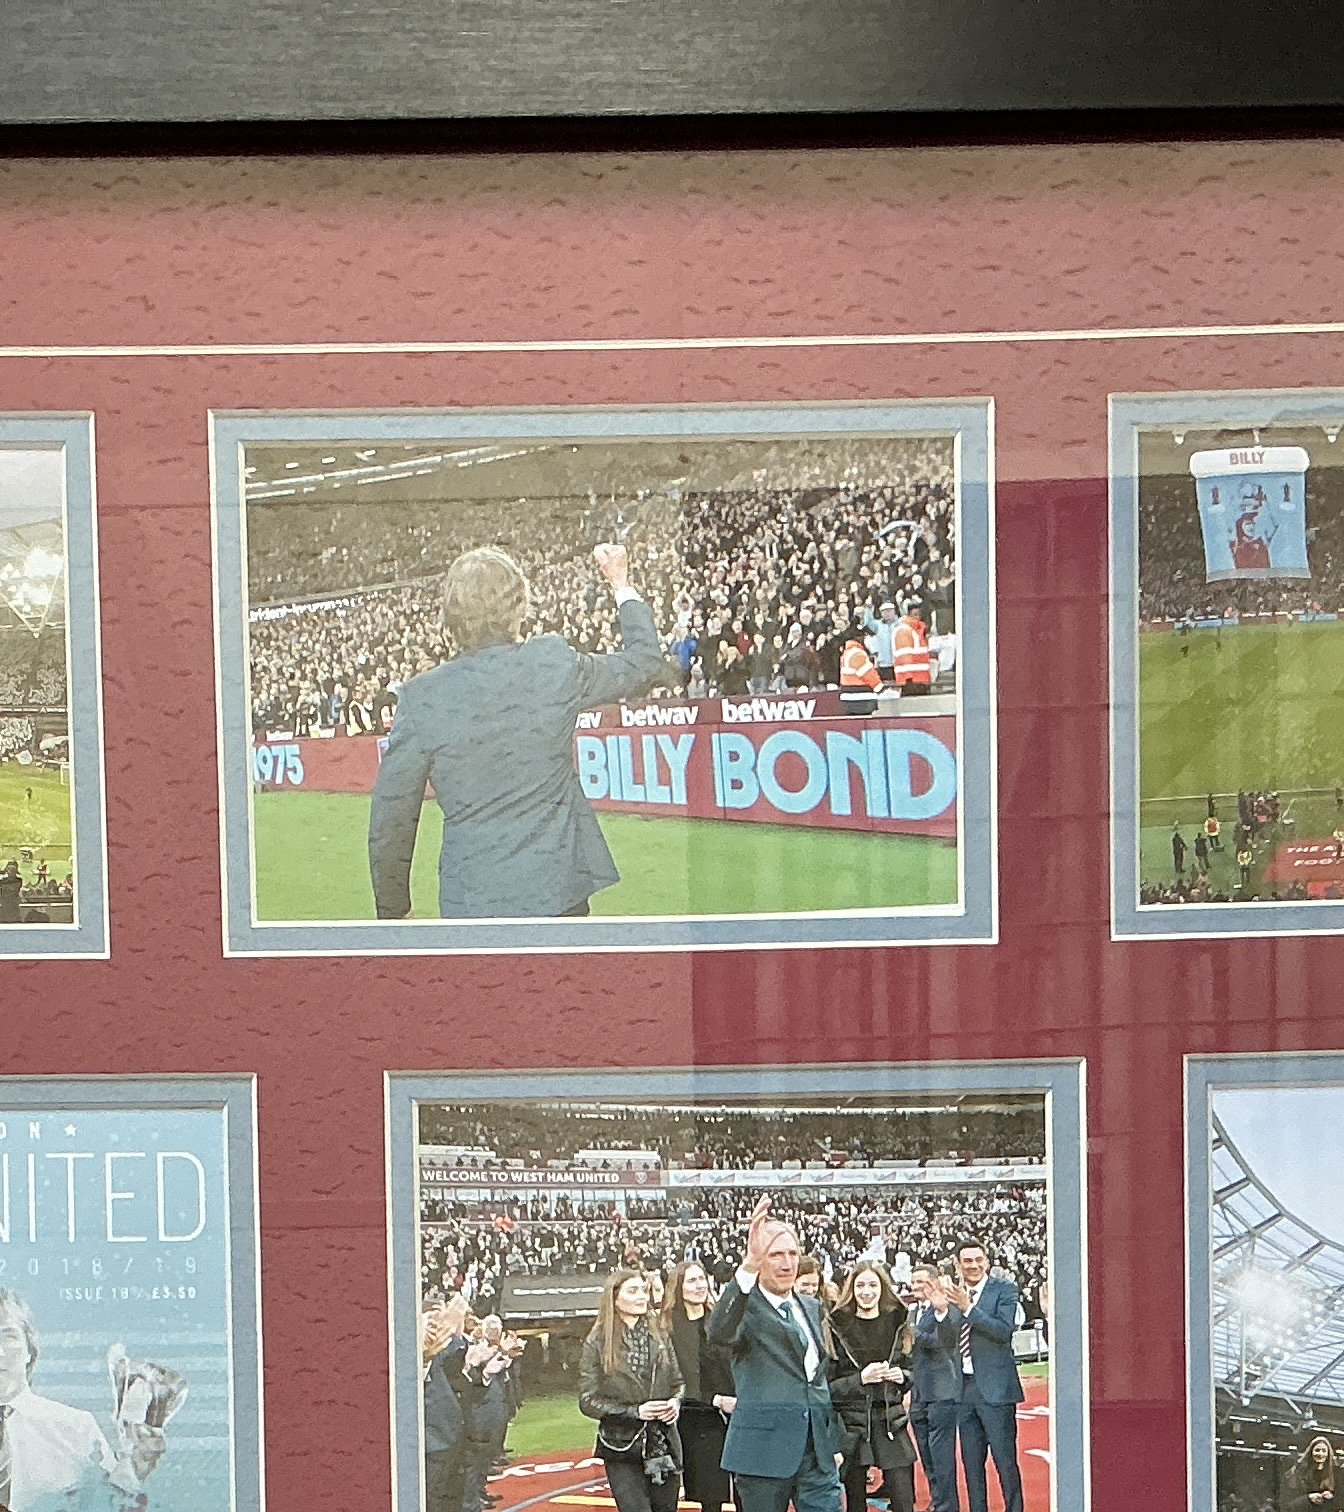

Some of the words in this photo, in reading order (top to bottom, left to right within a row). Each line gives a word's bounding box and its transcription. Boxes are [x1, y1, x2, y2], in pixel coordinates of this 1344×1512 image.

[1229, 451, 1265, 465] BILLY
[620, 704, 700, 727] betway
[721, 697, 816, 723] betway
[576, 733, 696, 806] BILLY
[711, 728, 957, 821] BOND
[422, 1169, 488, 1182] WELCOME
[490, 1170, 508, 1182] TO
[509, 1170, 545, 1183] WEST
[546, 1171, 575, 1183] HAM
[576, 1172, 620, 1184] UNITED
